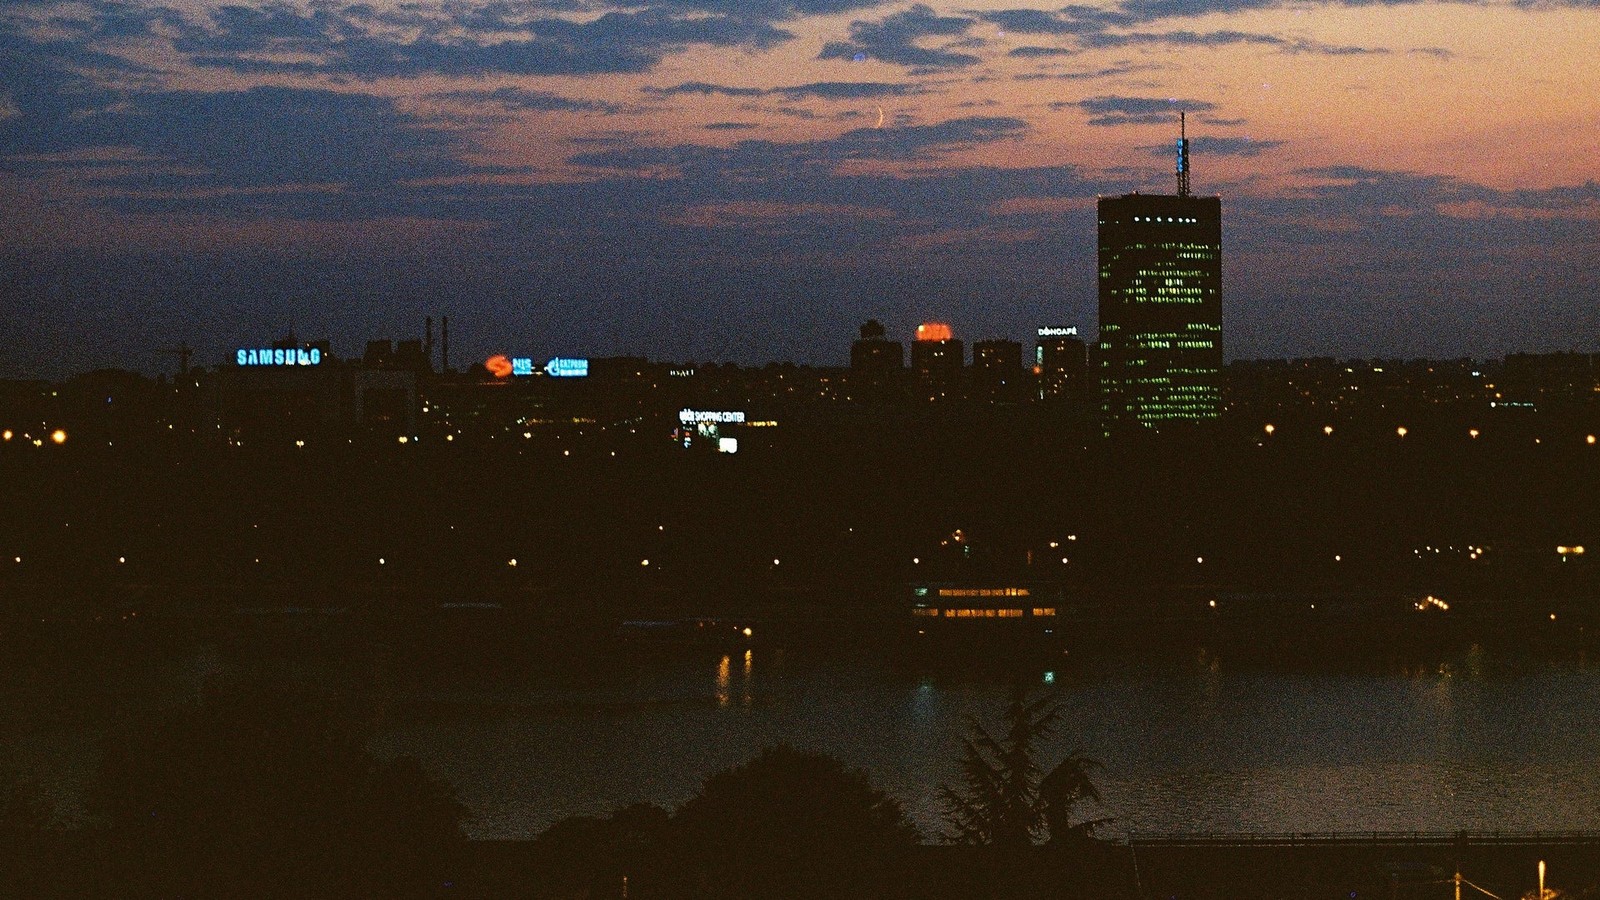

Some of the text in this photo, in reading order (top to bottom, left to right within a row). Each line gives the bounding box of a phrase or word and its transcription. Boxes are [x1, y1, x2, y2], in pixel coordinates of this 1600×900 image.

[237, 348, 321, 365] SAMSUNG
[512, 358, 531, 369] NIS
[695, 411, 722, 423] SHOPPING
[722, 411, 745, 423] CENTER
